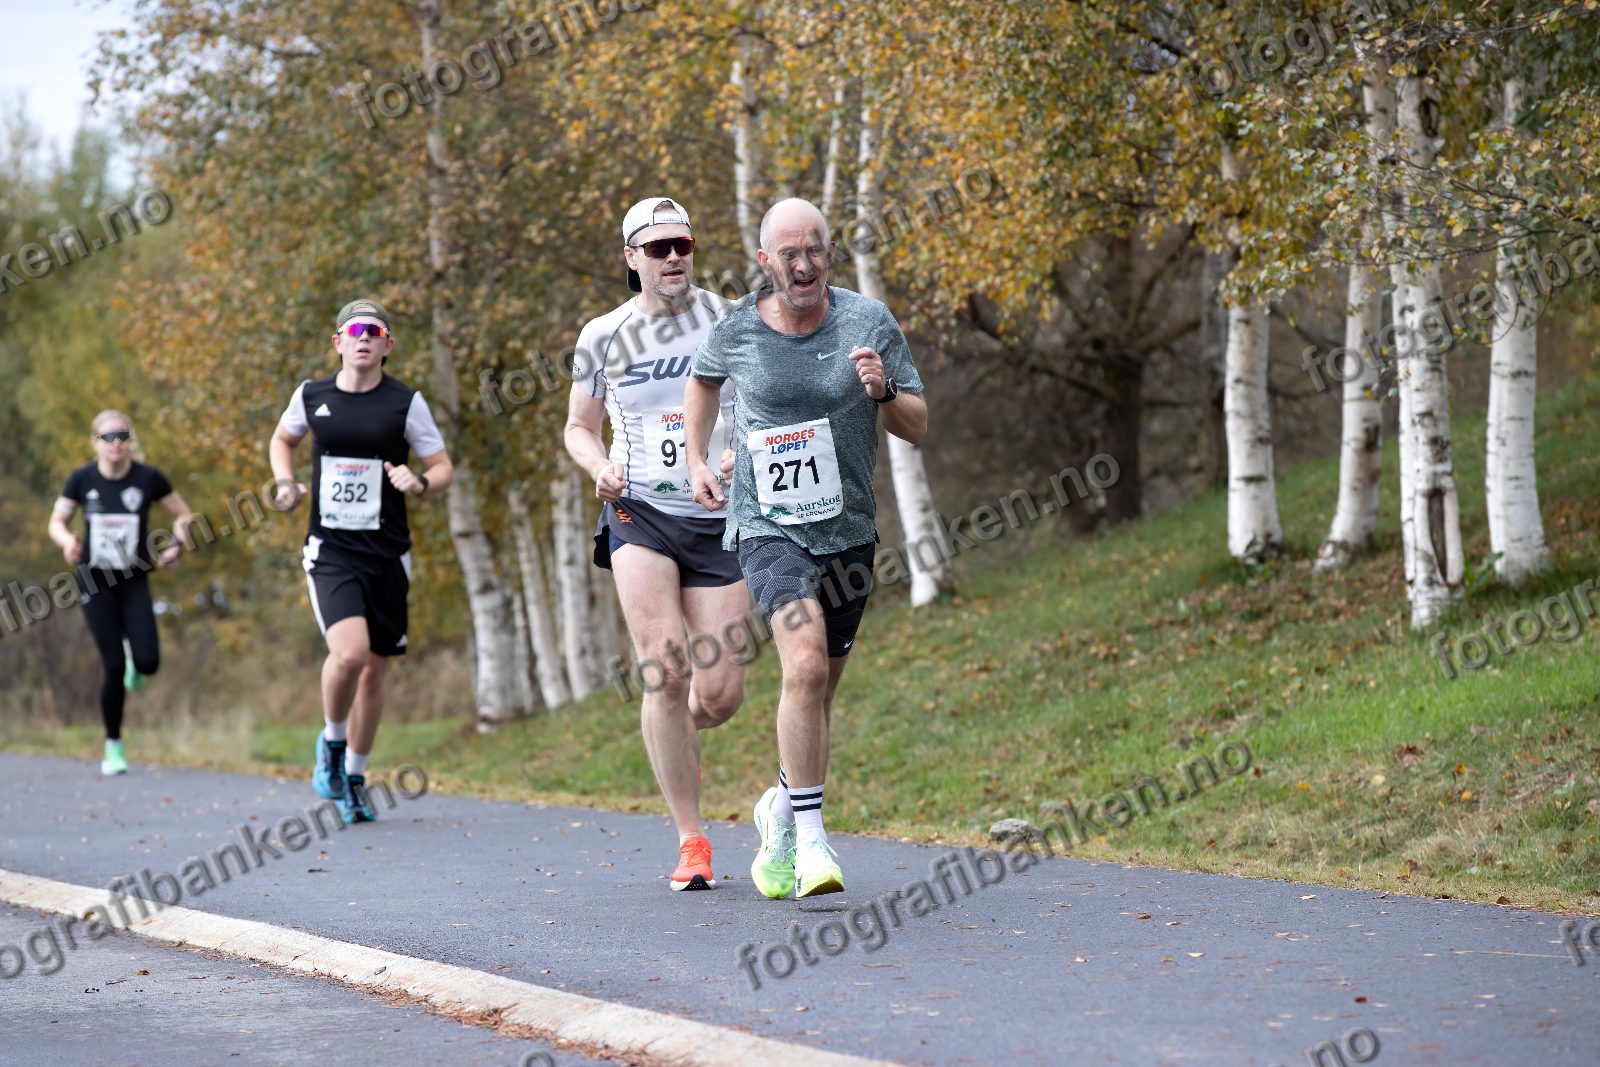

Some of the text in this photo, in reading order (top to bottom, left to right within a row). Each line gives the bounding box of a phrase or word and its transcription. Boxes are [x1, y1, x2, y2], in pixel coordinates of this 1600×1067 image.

[618, 356, 691, 388] SW
[764, 428, 816, 446] NORGES
[770, 440, 808, 455] LØPET
[661, 439, 685, 467] 9
[768, 455, 820, 492] 271
[332, 482, 368, 503] 252
[795, 494, 841, 513] Aurskog
